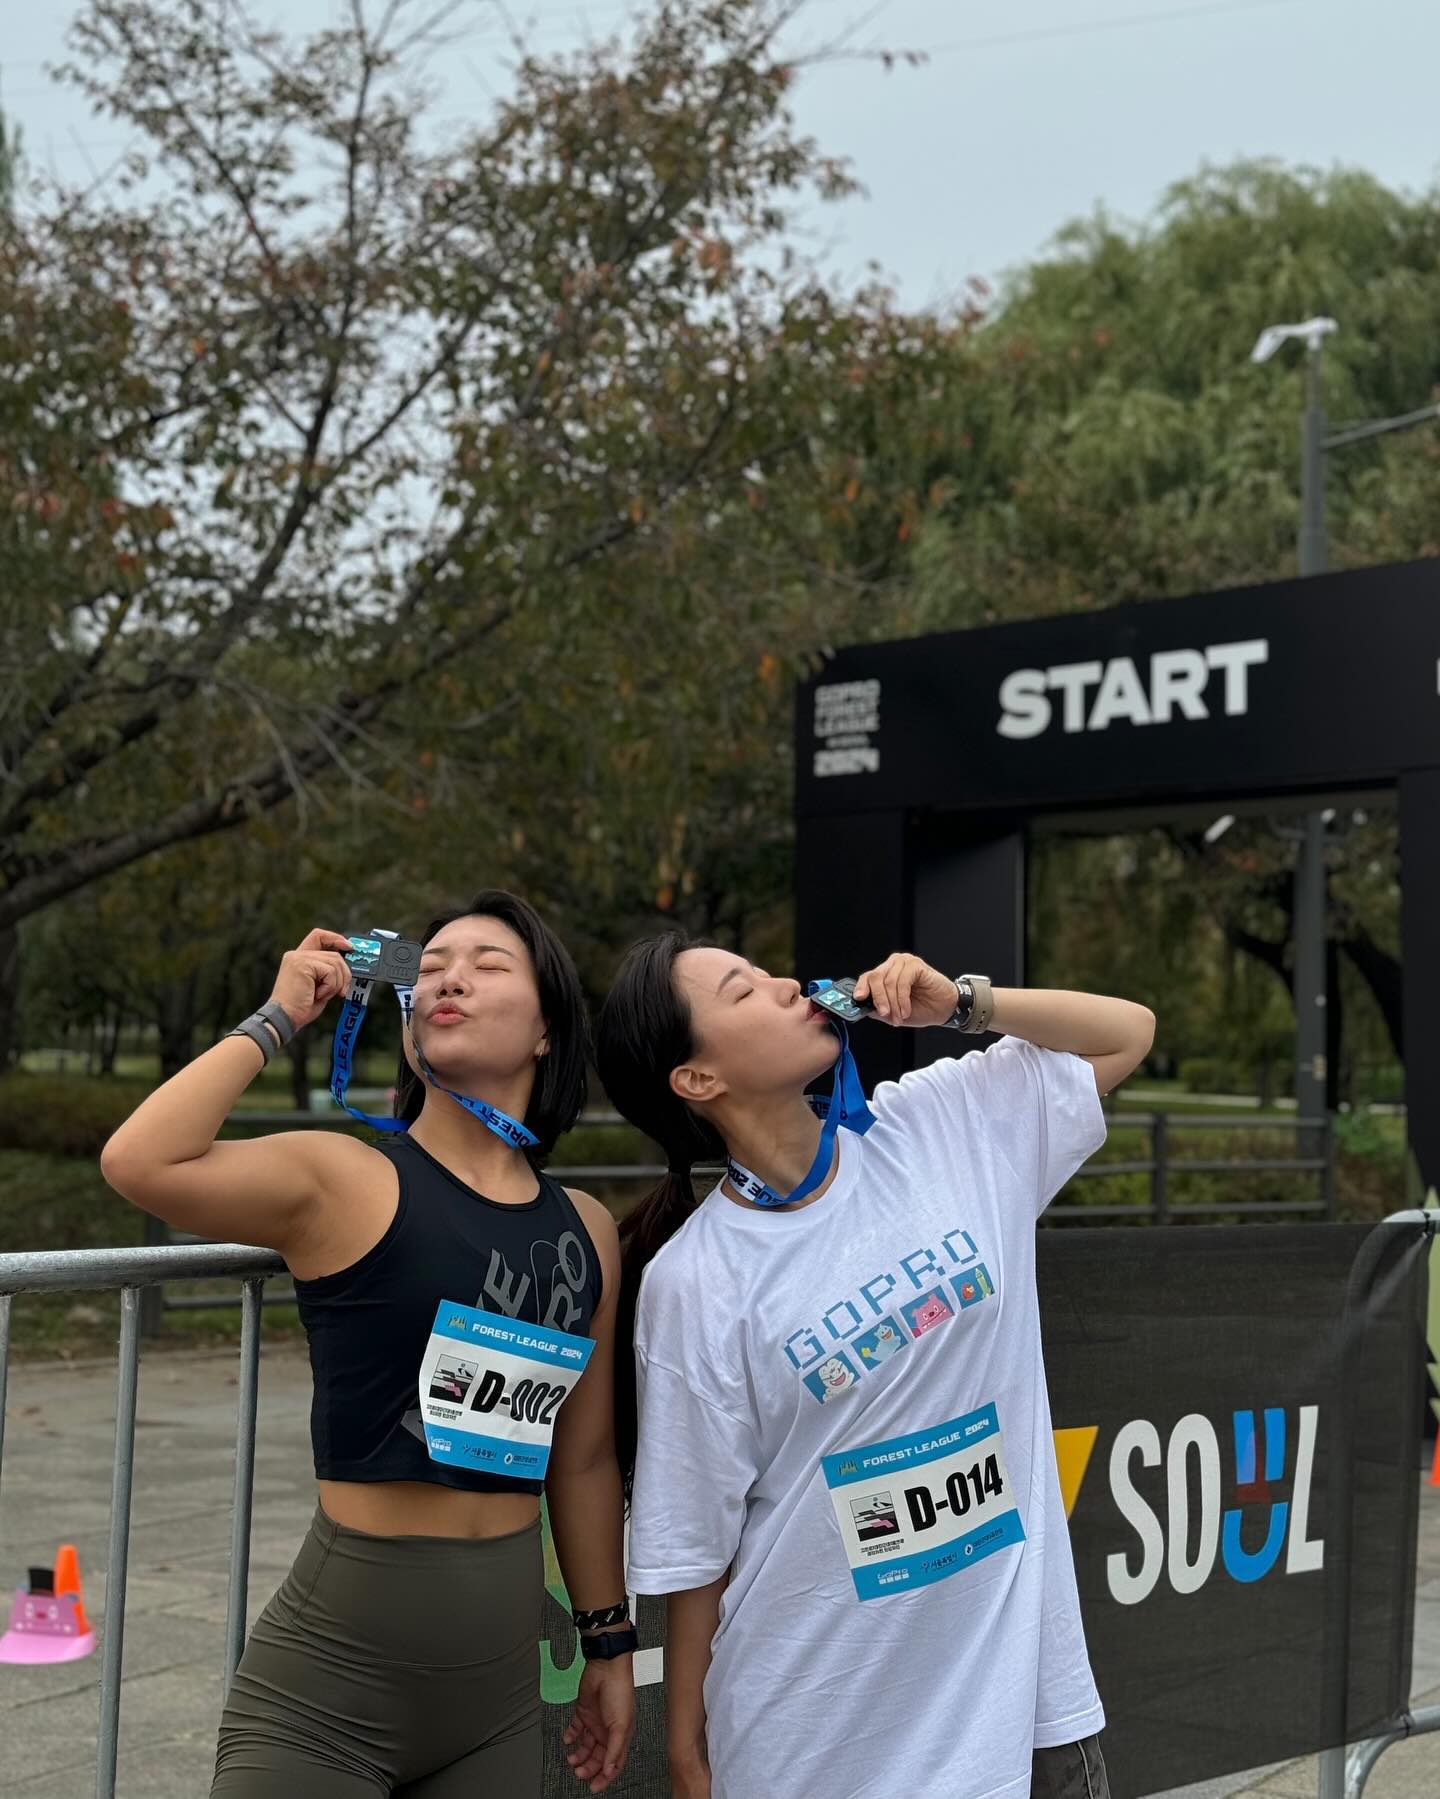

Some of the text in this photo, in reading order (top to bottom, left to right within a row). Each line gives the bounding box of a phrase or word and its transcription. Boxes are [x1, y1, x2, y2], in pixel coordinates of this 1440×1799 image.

[997, 639, 1269, 740] START
[338, 991, 365, 1072] LEAGUE
[478, 1106, 531, 1148] OREST
[784, 1229, 978, 1370] GOPRO
[472, 1323, 583, 1361] FOREST LEAGUE 2024
[470, 1370, 567, 1425] D-002
[863, 1418, 989, 1468] FOREST LEAGUE 2024
[904, 1453, 1003, 1532] D-014
[1106, 1405, 1325, 1605] SOUL
